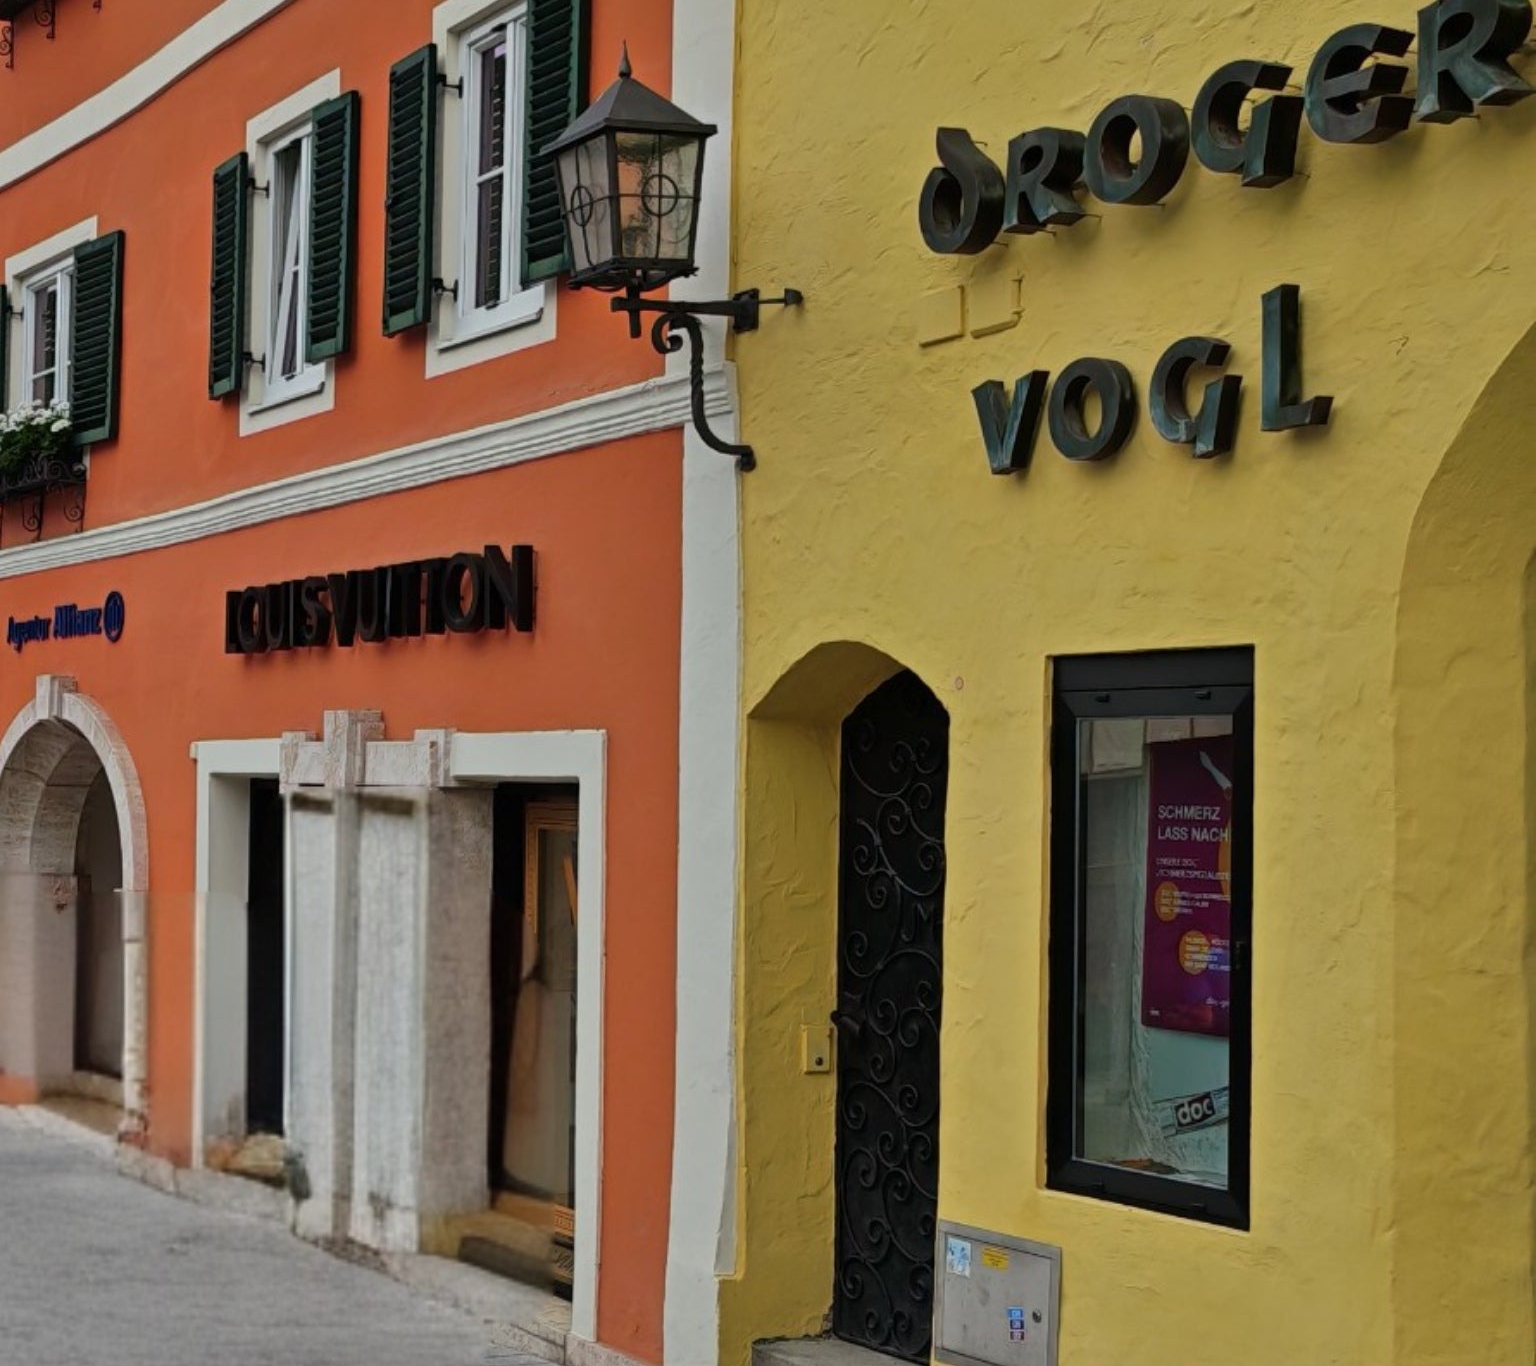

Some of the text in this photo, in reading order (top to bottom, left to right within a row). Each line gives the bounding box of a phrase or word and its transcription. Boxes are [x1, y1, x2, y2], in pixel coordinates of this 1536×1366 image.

[971, 283, 1335, 476] VOGL
[225, 544, 535, 654] LOUIS VUITTON
[54, 603, 102, 640] Allianz
[1157, 804, 1221, 821] SCHMERZ
[1157, 825, 1231, 843] LASS NACH
[1177, 1097, 1214, 1125] doc
